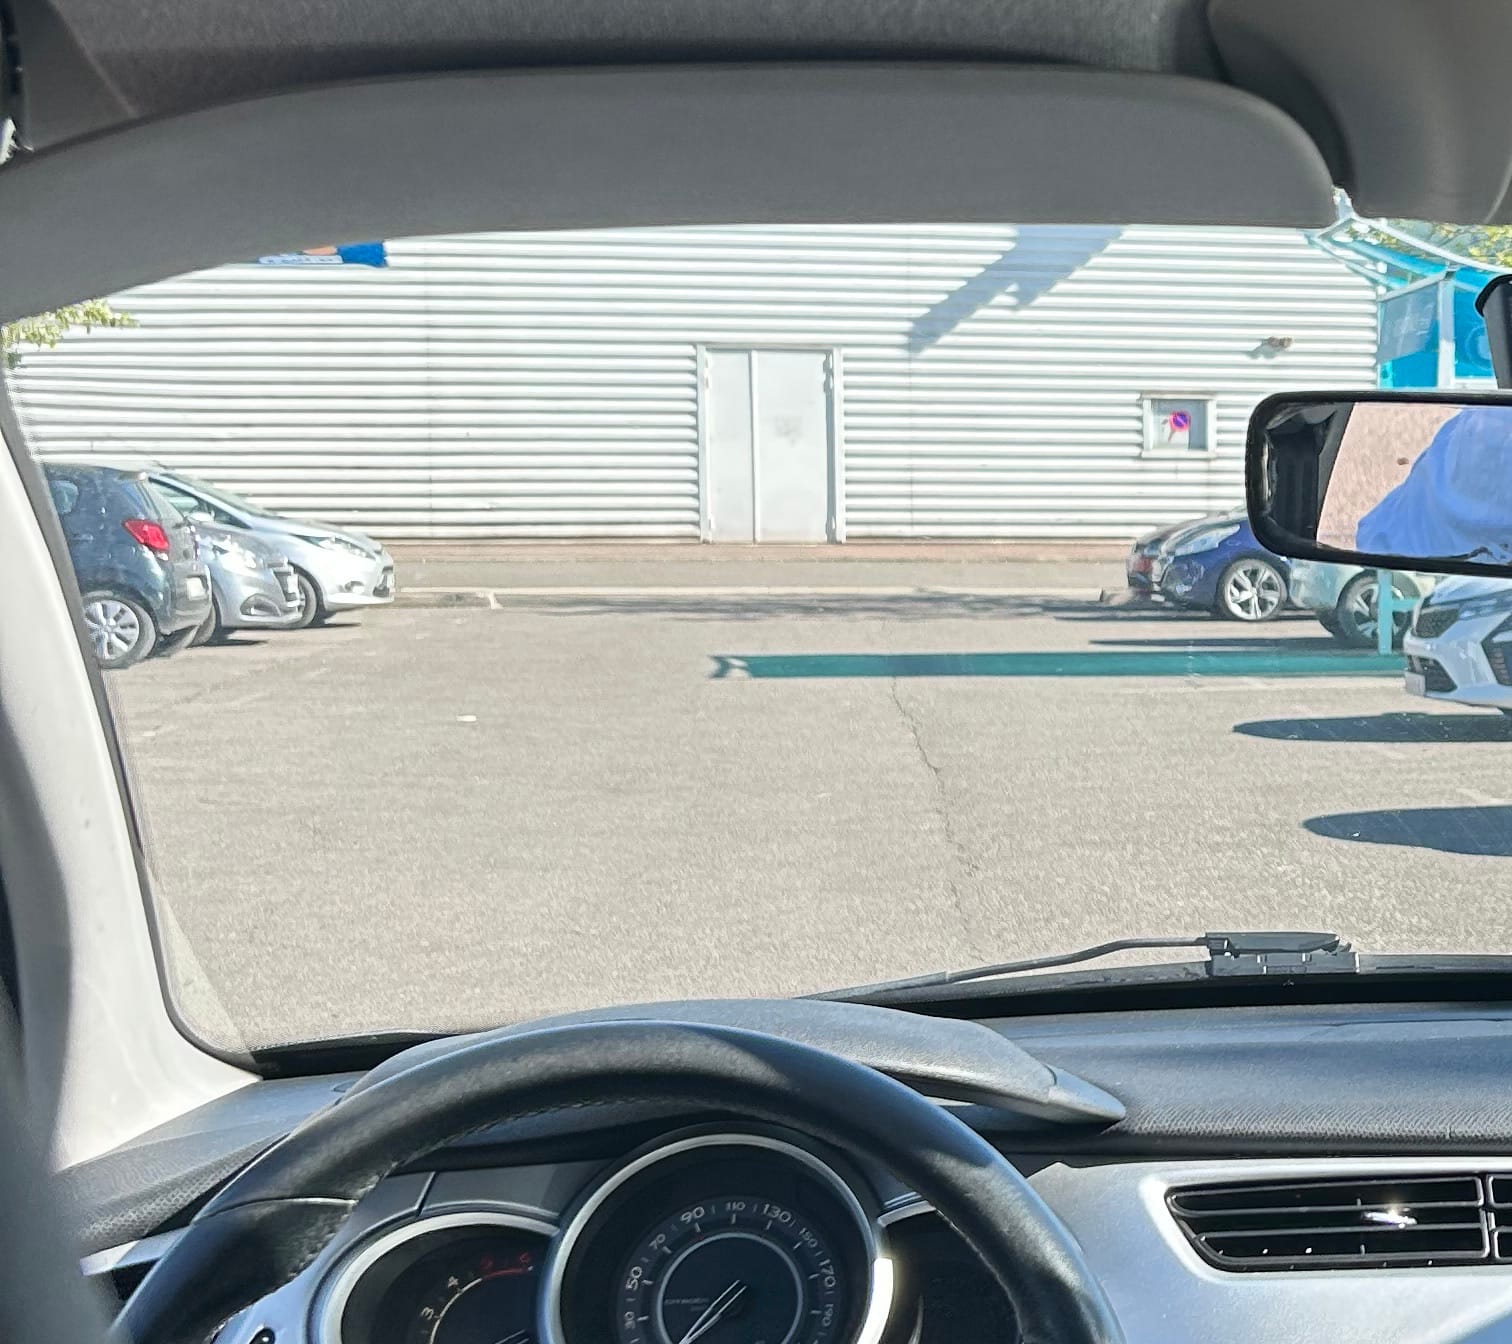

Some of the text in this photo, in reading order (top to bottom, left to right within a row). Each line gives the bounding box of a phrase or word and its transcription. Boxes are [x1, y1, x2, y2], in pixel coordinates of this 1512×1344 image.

[680, 1206, 705, 1224] 90
[762, 1203, 792, 1224] 130
[649, 1233, 667, 1250] 70
[799, 1227, 819, 1248] 150
[625, 1266, 643, 1291] 50
[818, 1258, 836, 1287] 170
[447, 1276, 459, 1288] 4
[421, 1307, 434, 1320] 3
[624, 1311, 636, 1329] 30
